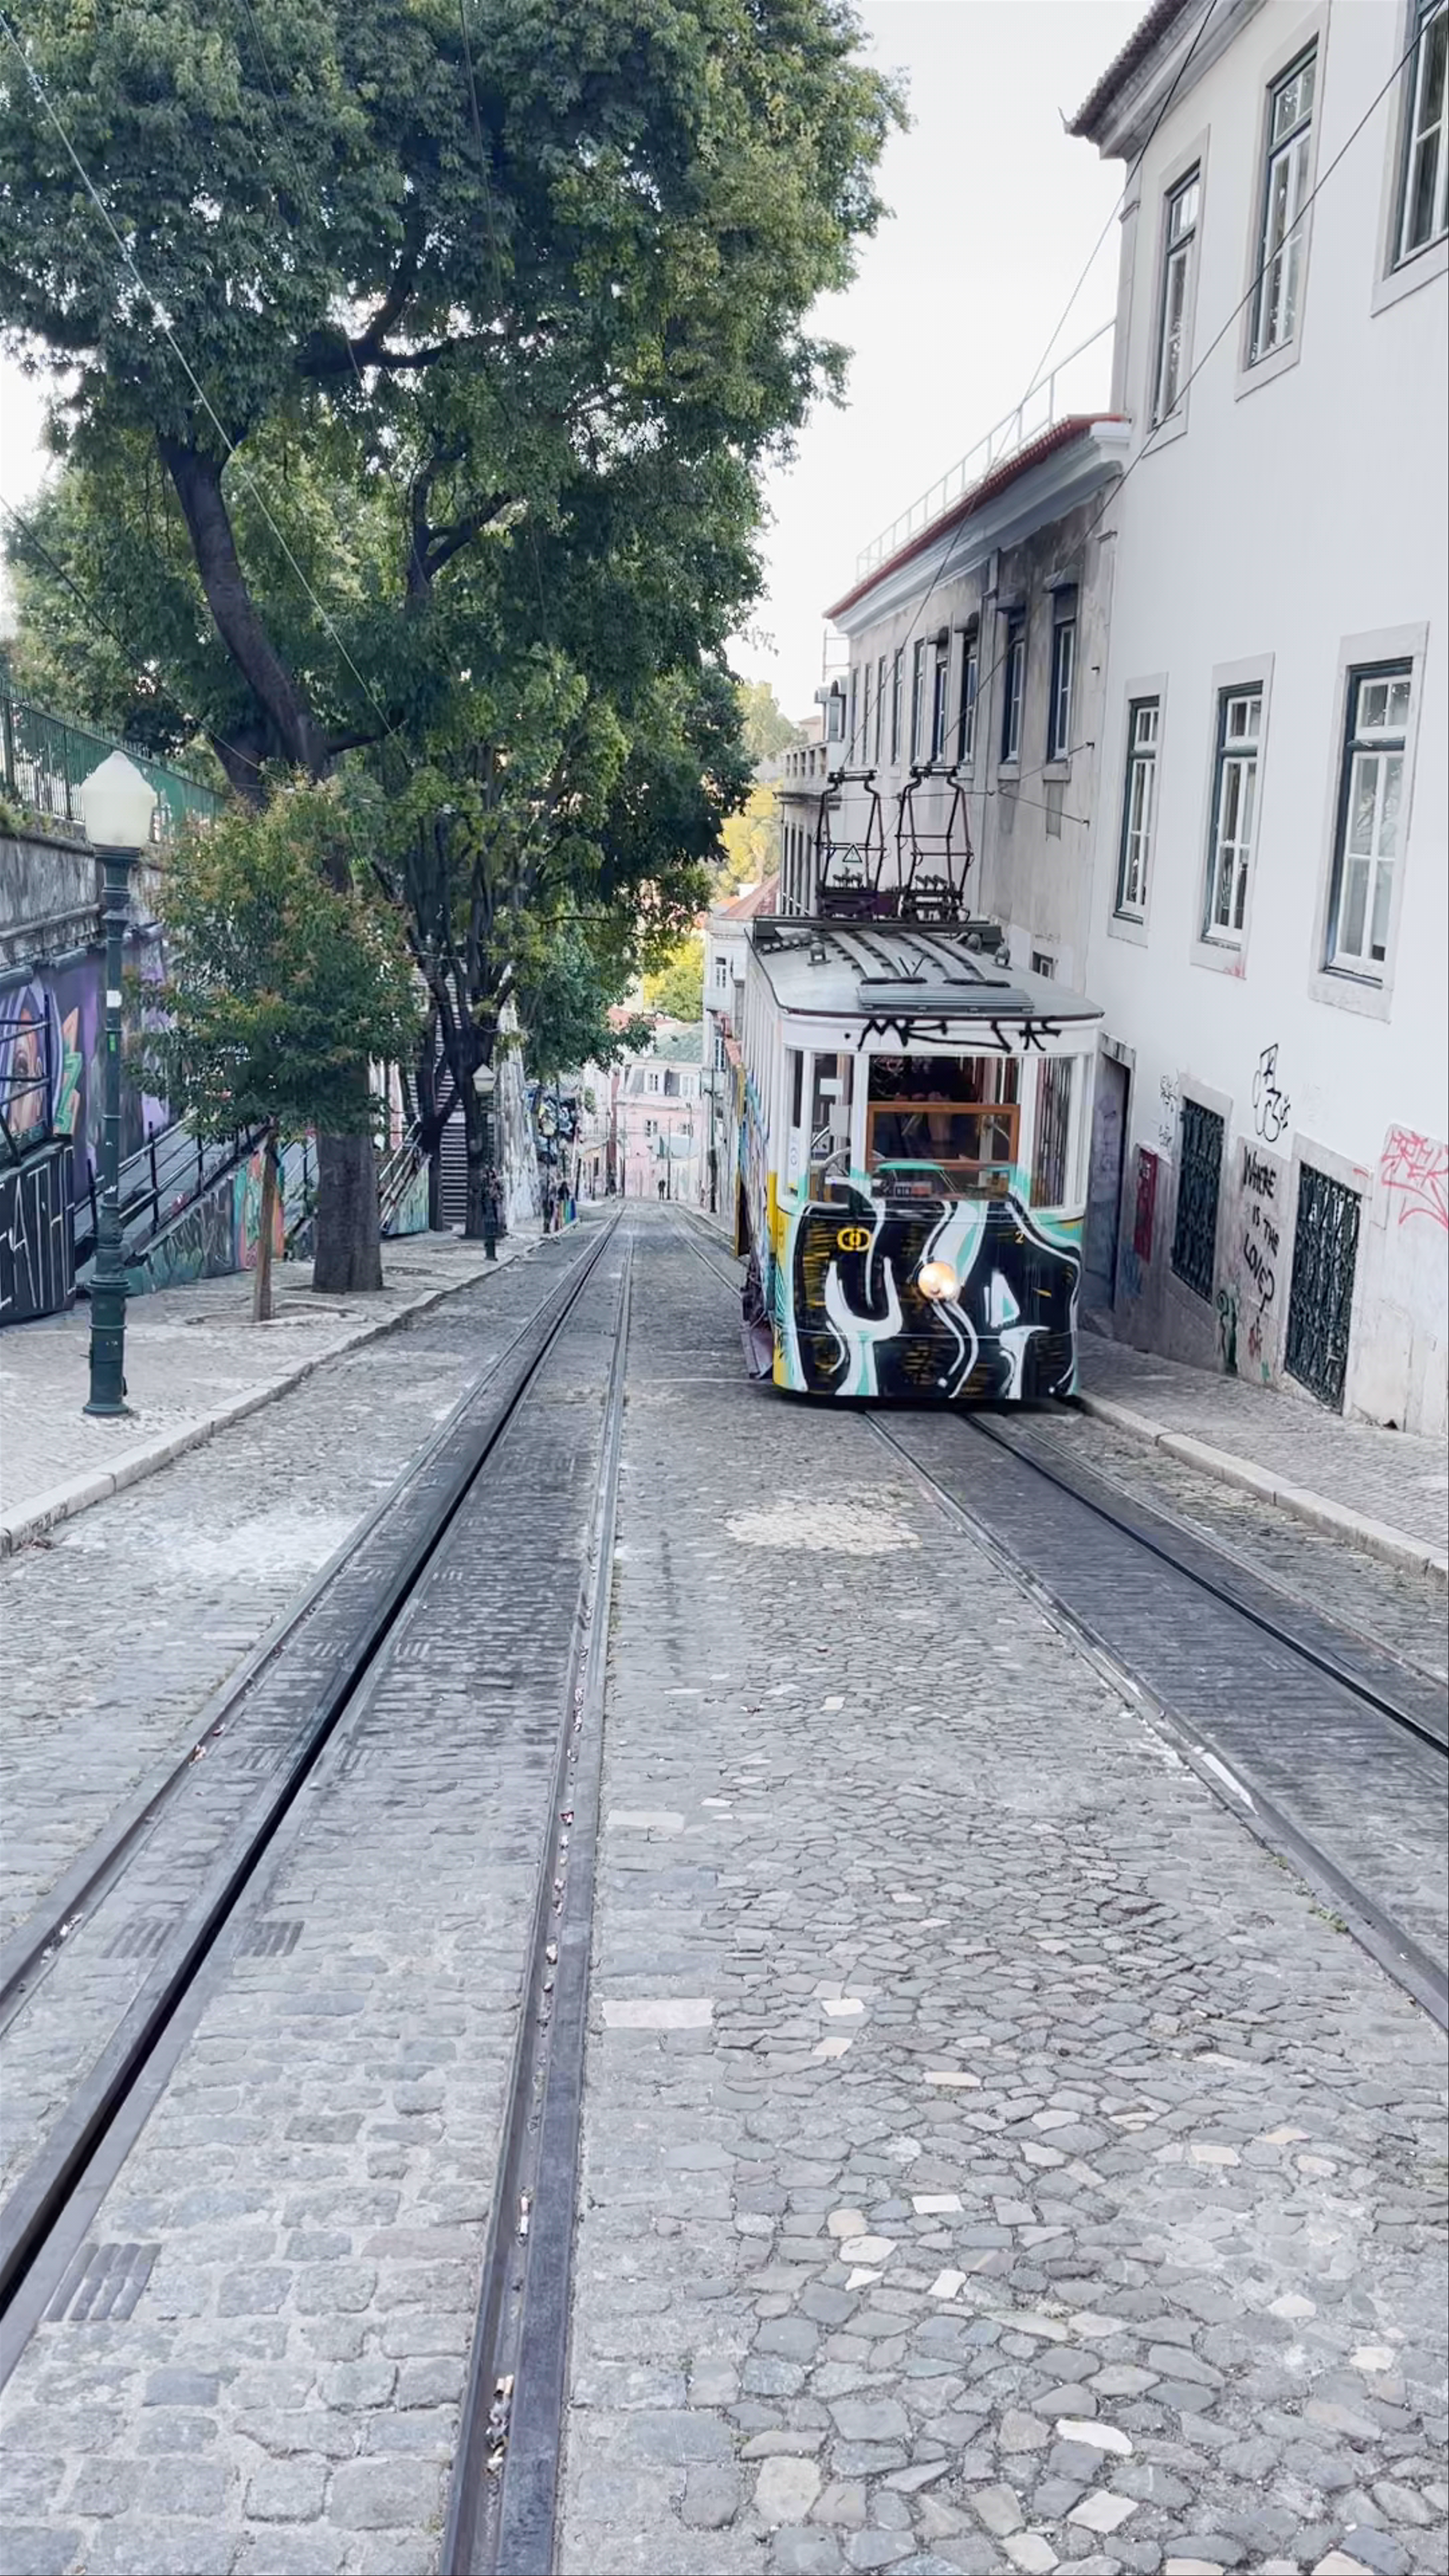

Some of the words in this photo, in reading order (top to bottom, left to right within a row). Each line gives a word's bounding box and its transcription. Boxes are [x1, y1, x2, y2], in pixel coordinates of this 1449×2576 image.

[1243, 1146, 1276, 1199] WHERE
[1015, 1230, 1024, 1244] 2
[1252, 1206, 1260, 1226] IS
[1263, 1218, 1280, 1258] THE
